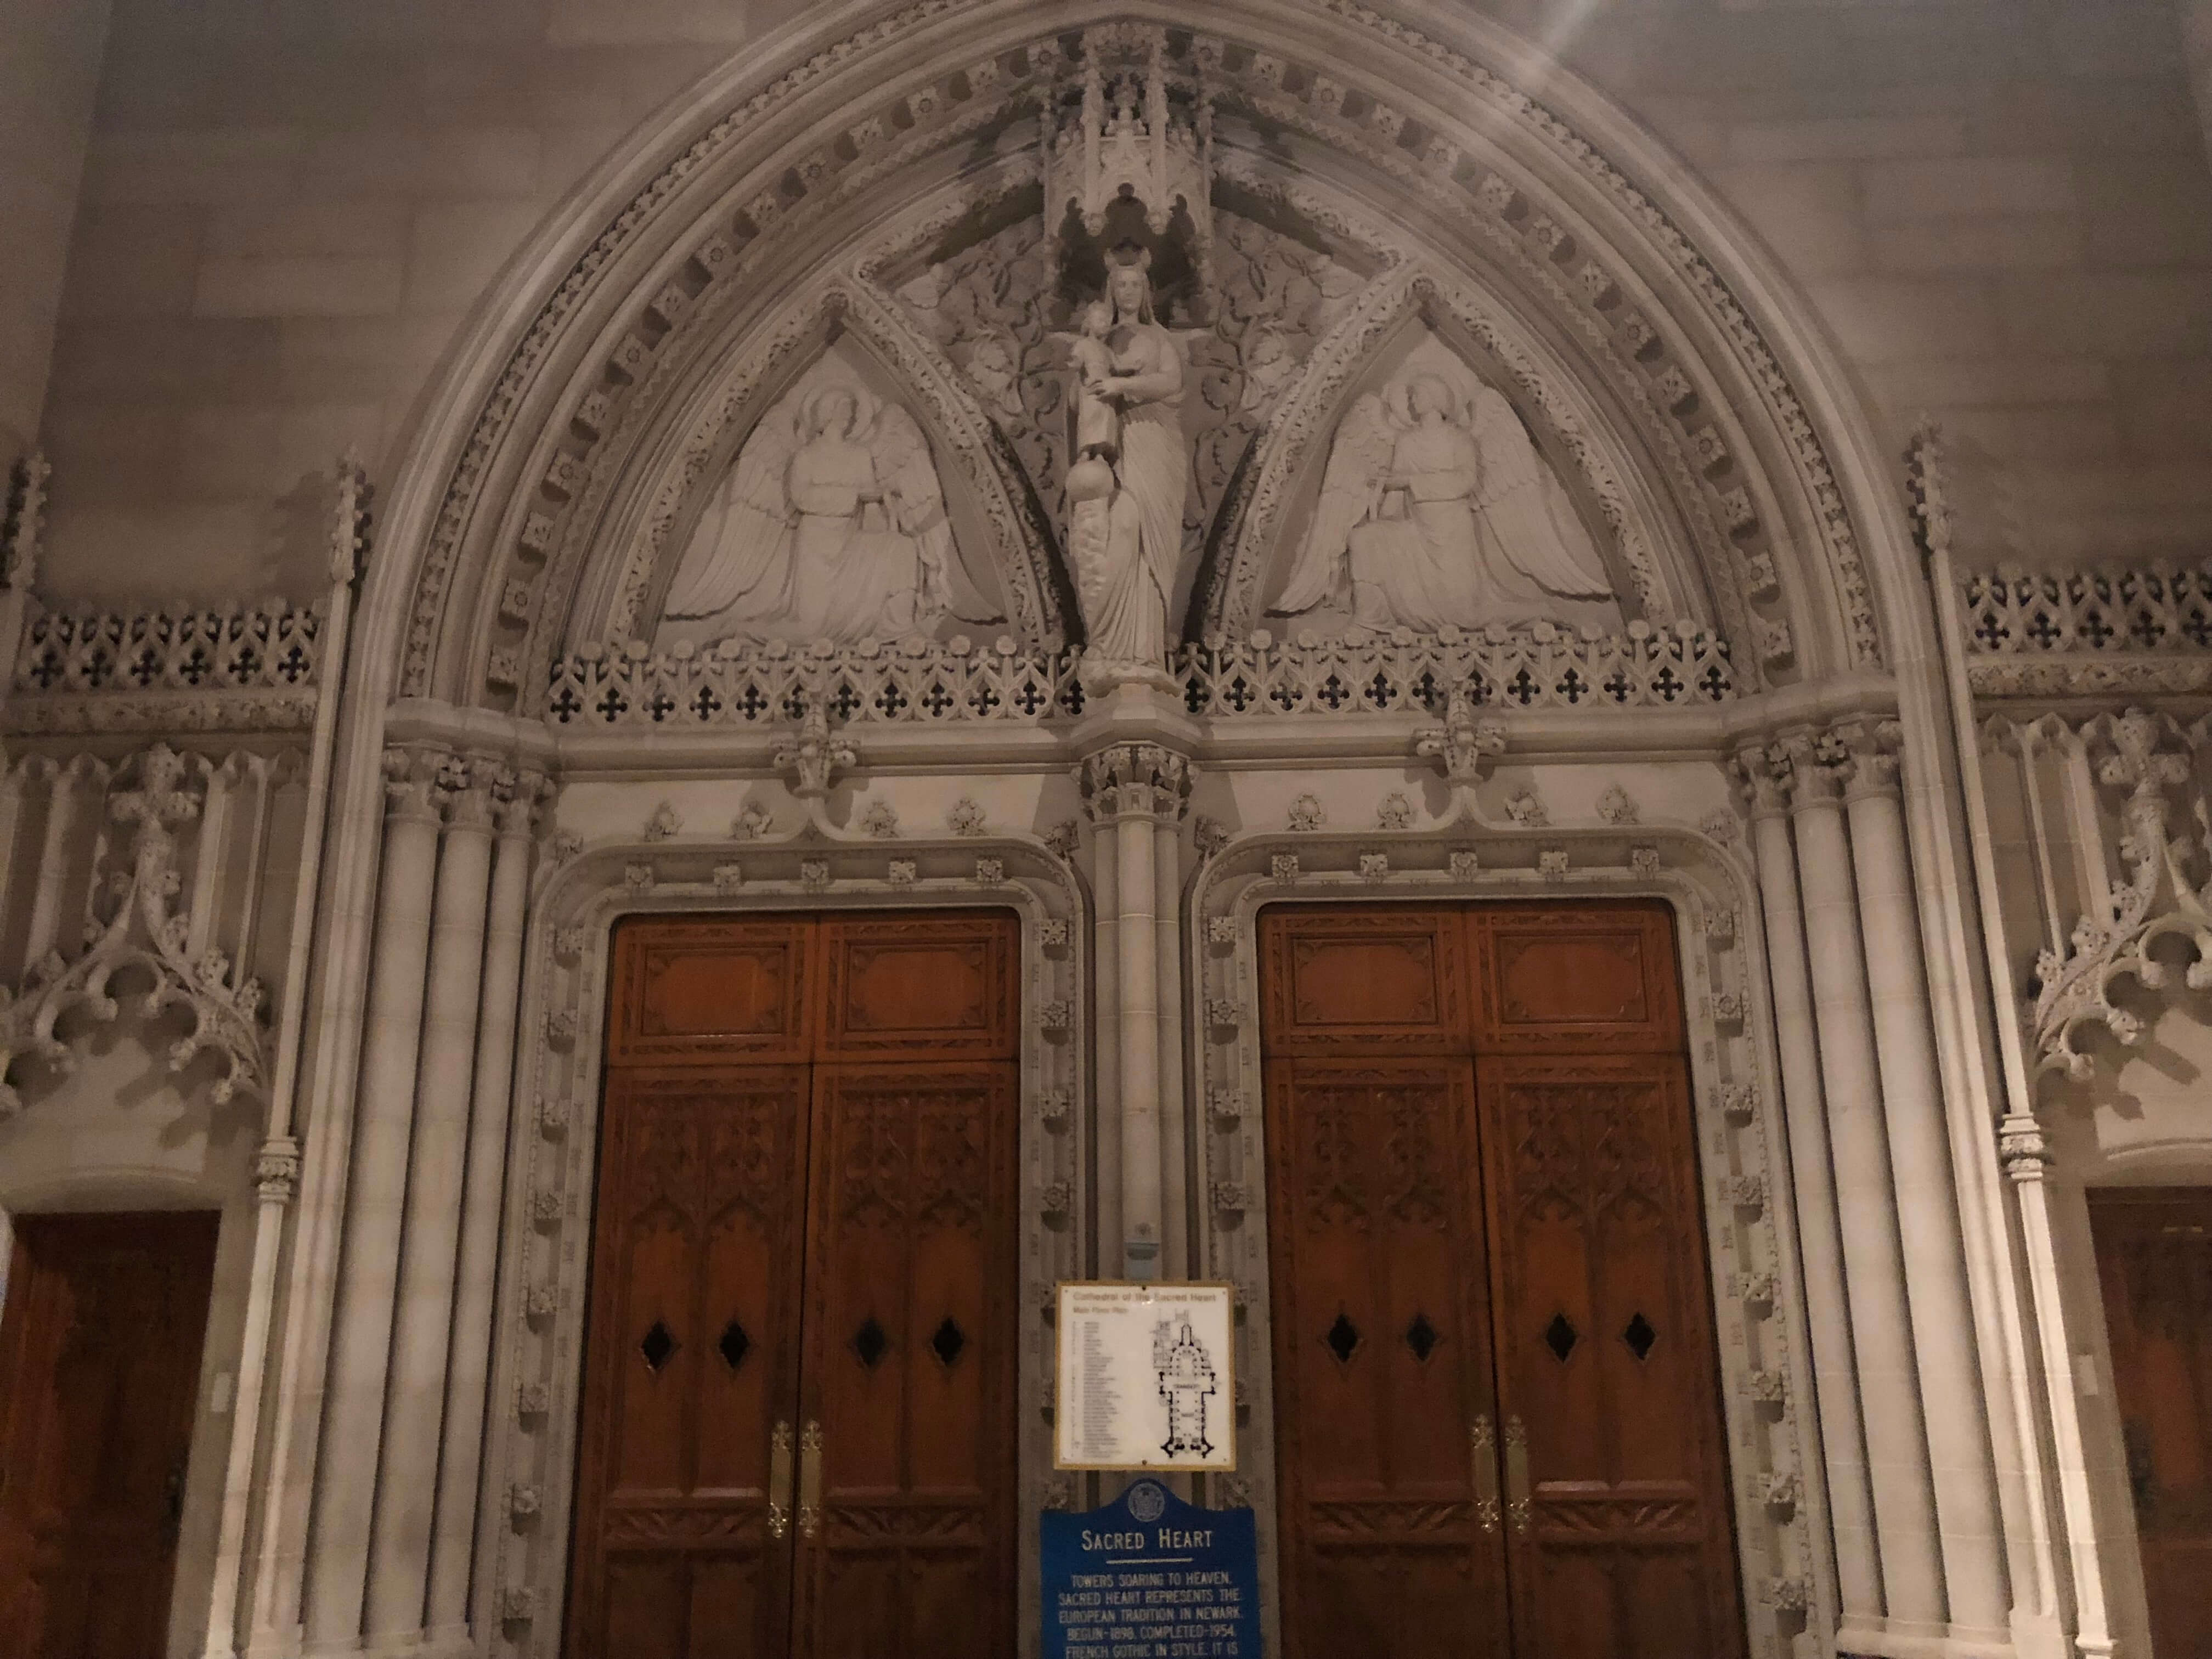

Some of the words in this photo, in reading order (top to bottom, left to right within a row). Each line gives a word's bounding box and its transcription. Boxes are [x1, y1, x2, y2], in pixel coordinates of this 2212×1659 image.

[1081, 1530, 1144, 1550] SACRED
[1159, 1528, 1212, 1548] HEART
[1071, 1574, 1114, 1588] TOWERS
[1119, 1573, 1164, 1587] SOARING
[1167, 1572, 1181, 1585] TO
[1058, 1592, 1101, 1606] SACRED
[1105, 1591, 1140, 1605] HEART
[1145, 1589, 1213, 1603] REPRESENTS
[1220, 1588, 1240, 1601] THE
[1059, 1610, 1115, 1624] EUROPEAN
[1121, 1608, 1174, 1622] TRADITION
[1180, 1607, 1191, 1620] IN
[1066, 1646, 1109, 1659] FRENCH
[1113, 1644, 1150, 1658] GOTHIC
[1155, 1643, 1167, 1656] IN
[1212, 1641, 1222, 1655] IT
[1227, 1641, 1238, 1655] IS
